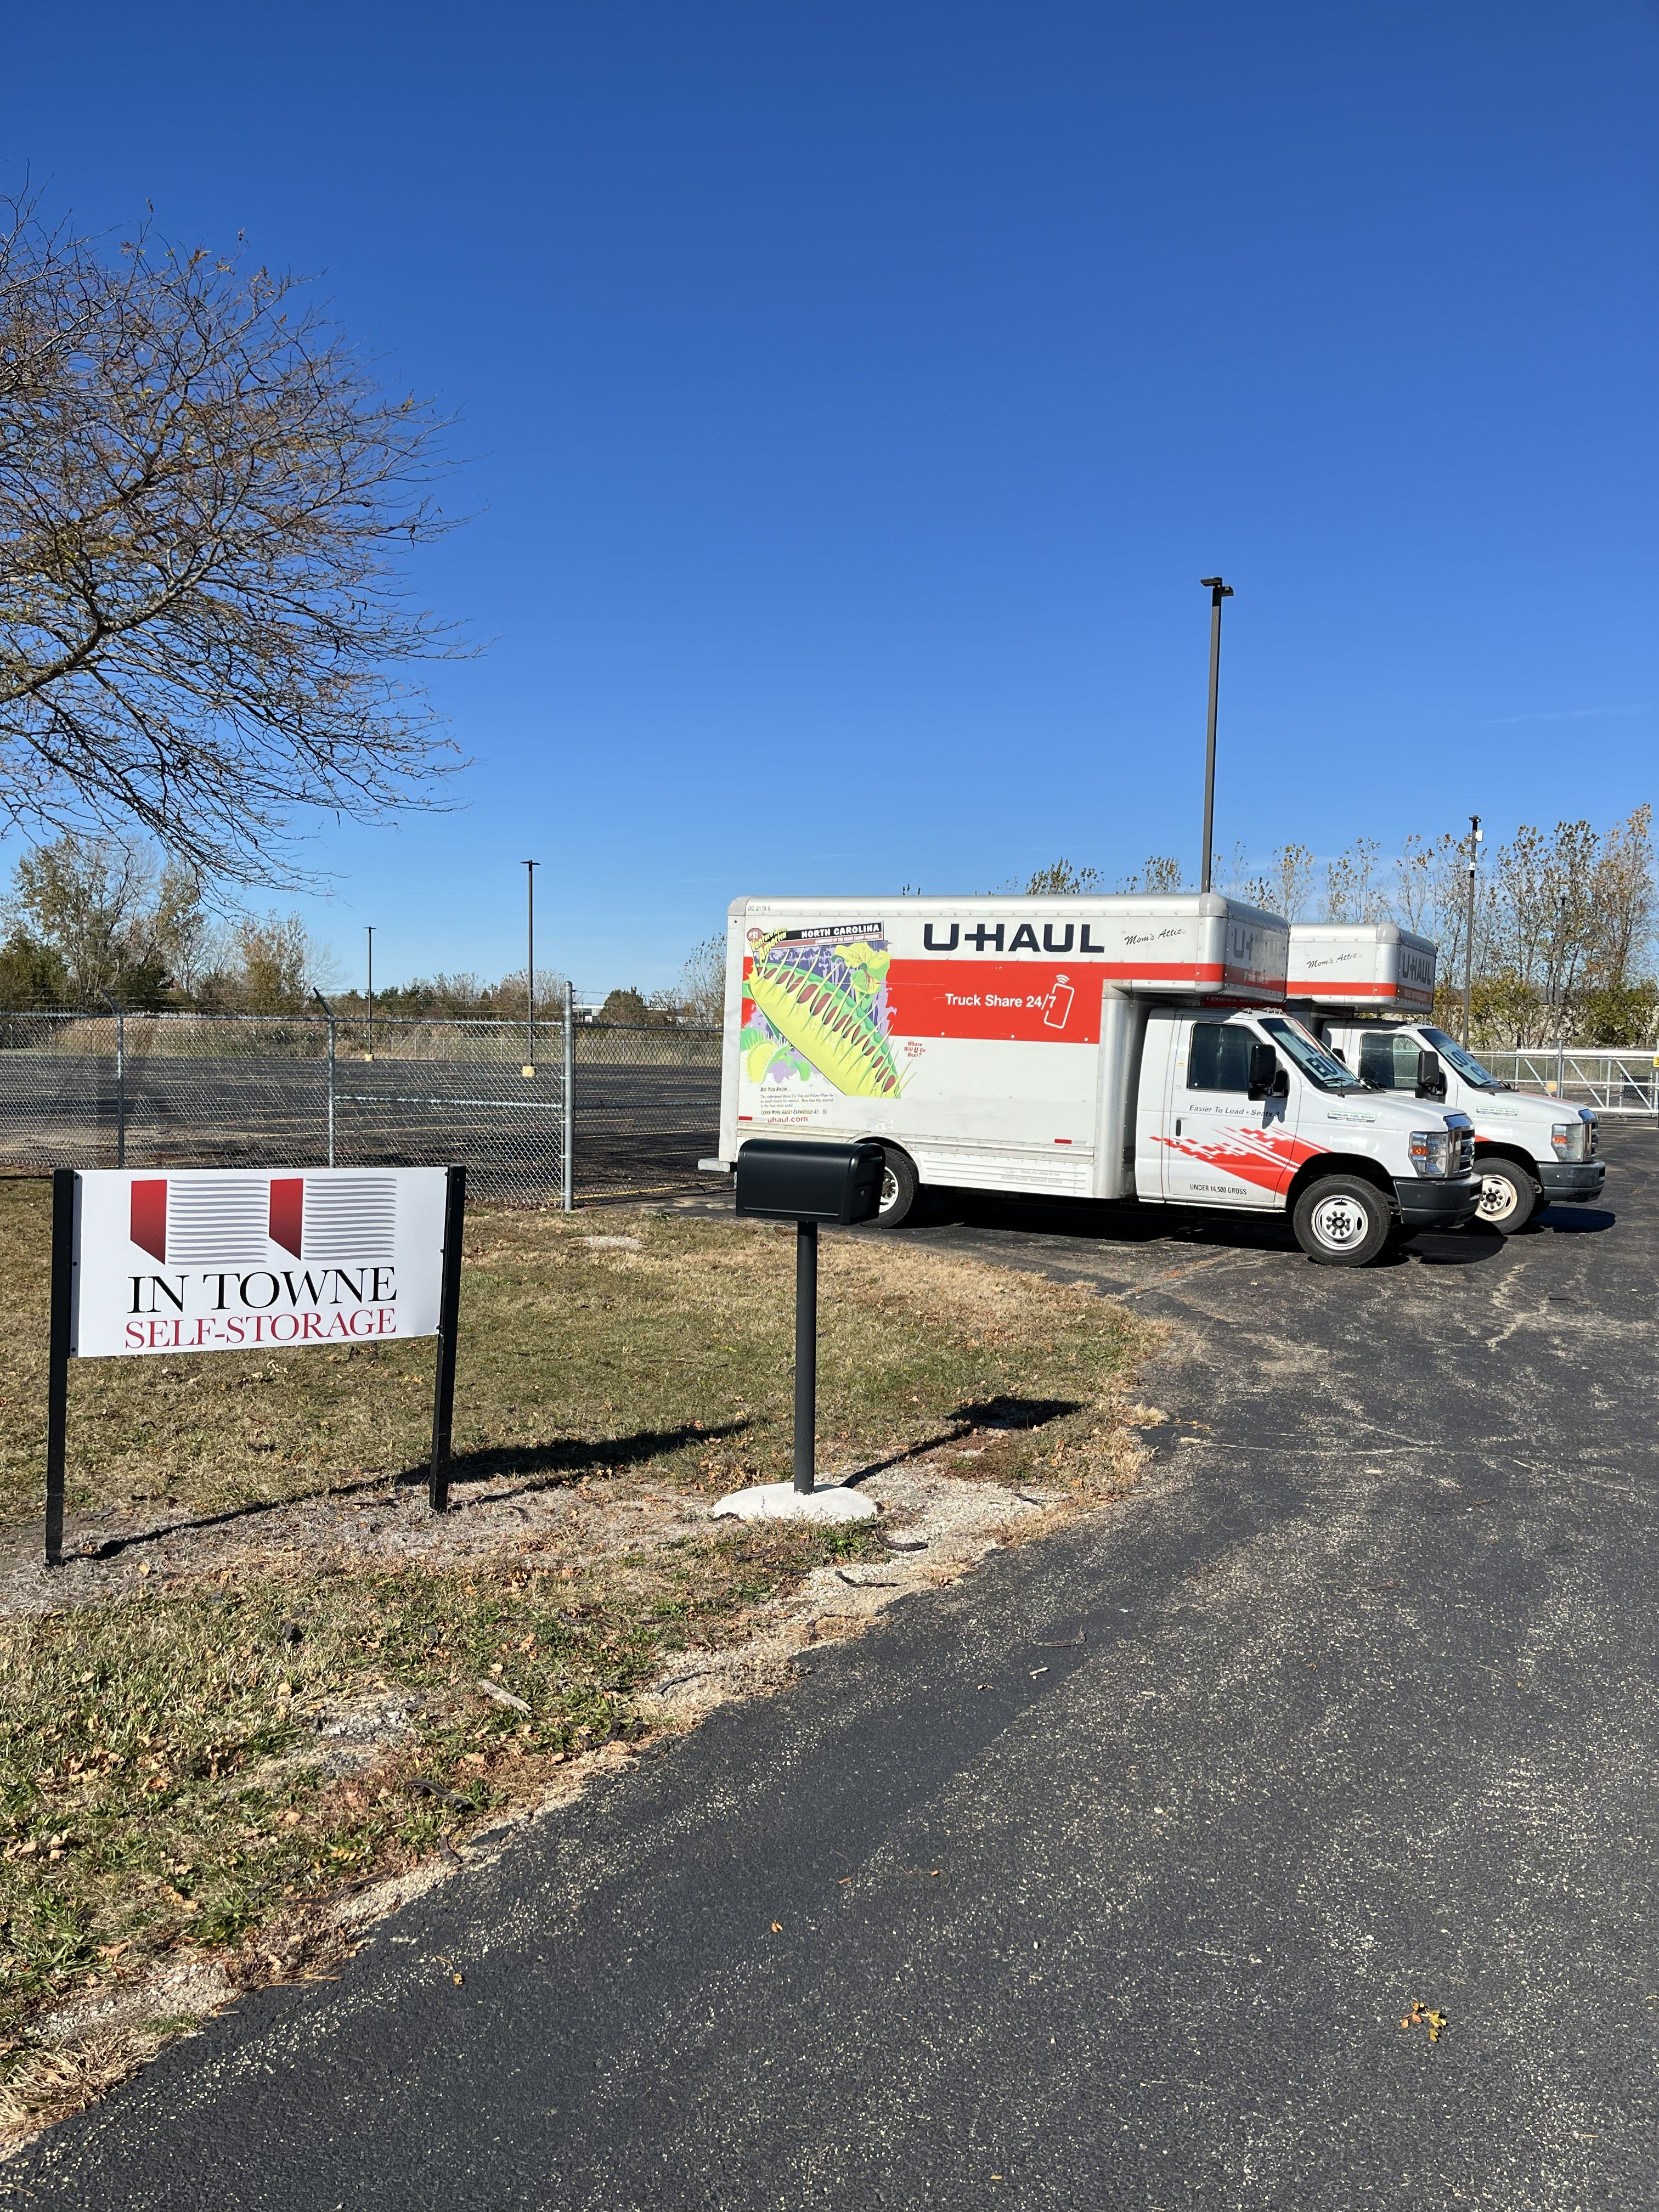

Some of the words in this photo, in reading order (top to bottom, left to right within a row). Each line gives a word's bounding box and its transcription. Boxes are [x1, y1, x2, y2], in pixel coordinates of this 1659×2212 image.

[801, 928, 831, 939] NORTH
[833, 924, 879, 935] CAROLINA
[923, 923, 1105, 953] U-HAUL
[1124, 933, 1155, 945] Mom's
[1157, 928, 1183, 939] Attic
[759, 932, 787, 964] America
[1307, 958, 1333, 969] Mom's
[1335, 952, 1358, 963] Attic
[945, 993, 981, 1007] Truck
[985, 994, 1023, 1008] Share
[1026, 994, 1057, 1011] 24/7
[1251, 1109, 1273, 1118] Seats
[1189, 1183, 1209, 1192] UNDER
[127, 1274, 190, 1313] IN
[202, 1266, 398, 1311] TOWNE
[125, 1308, 397, 1349] SELF-STORAGE
